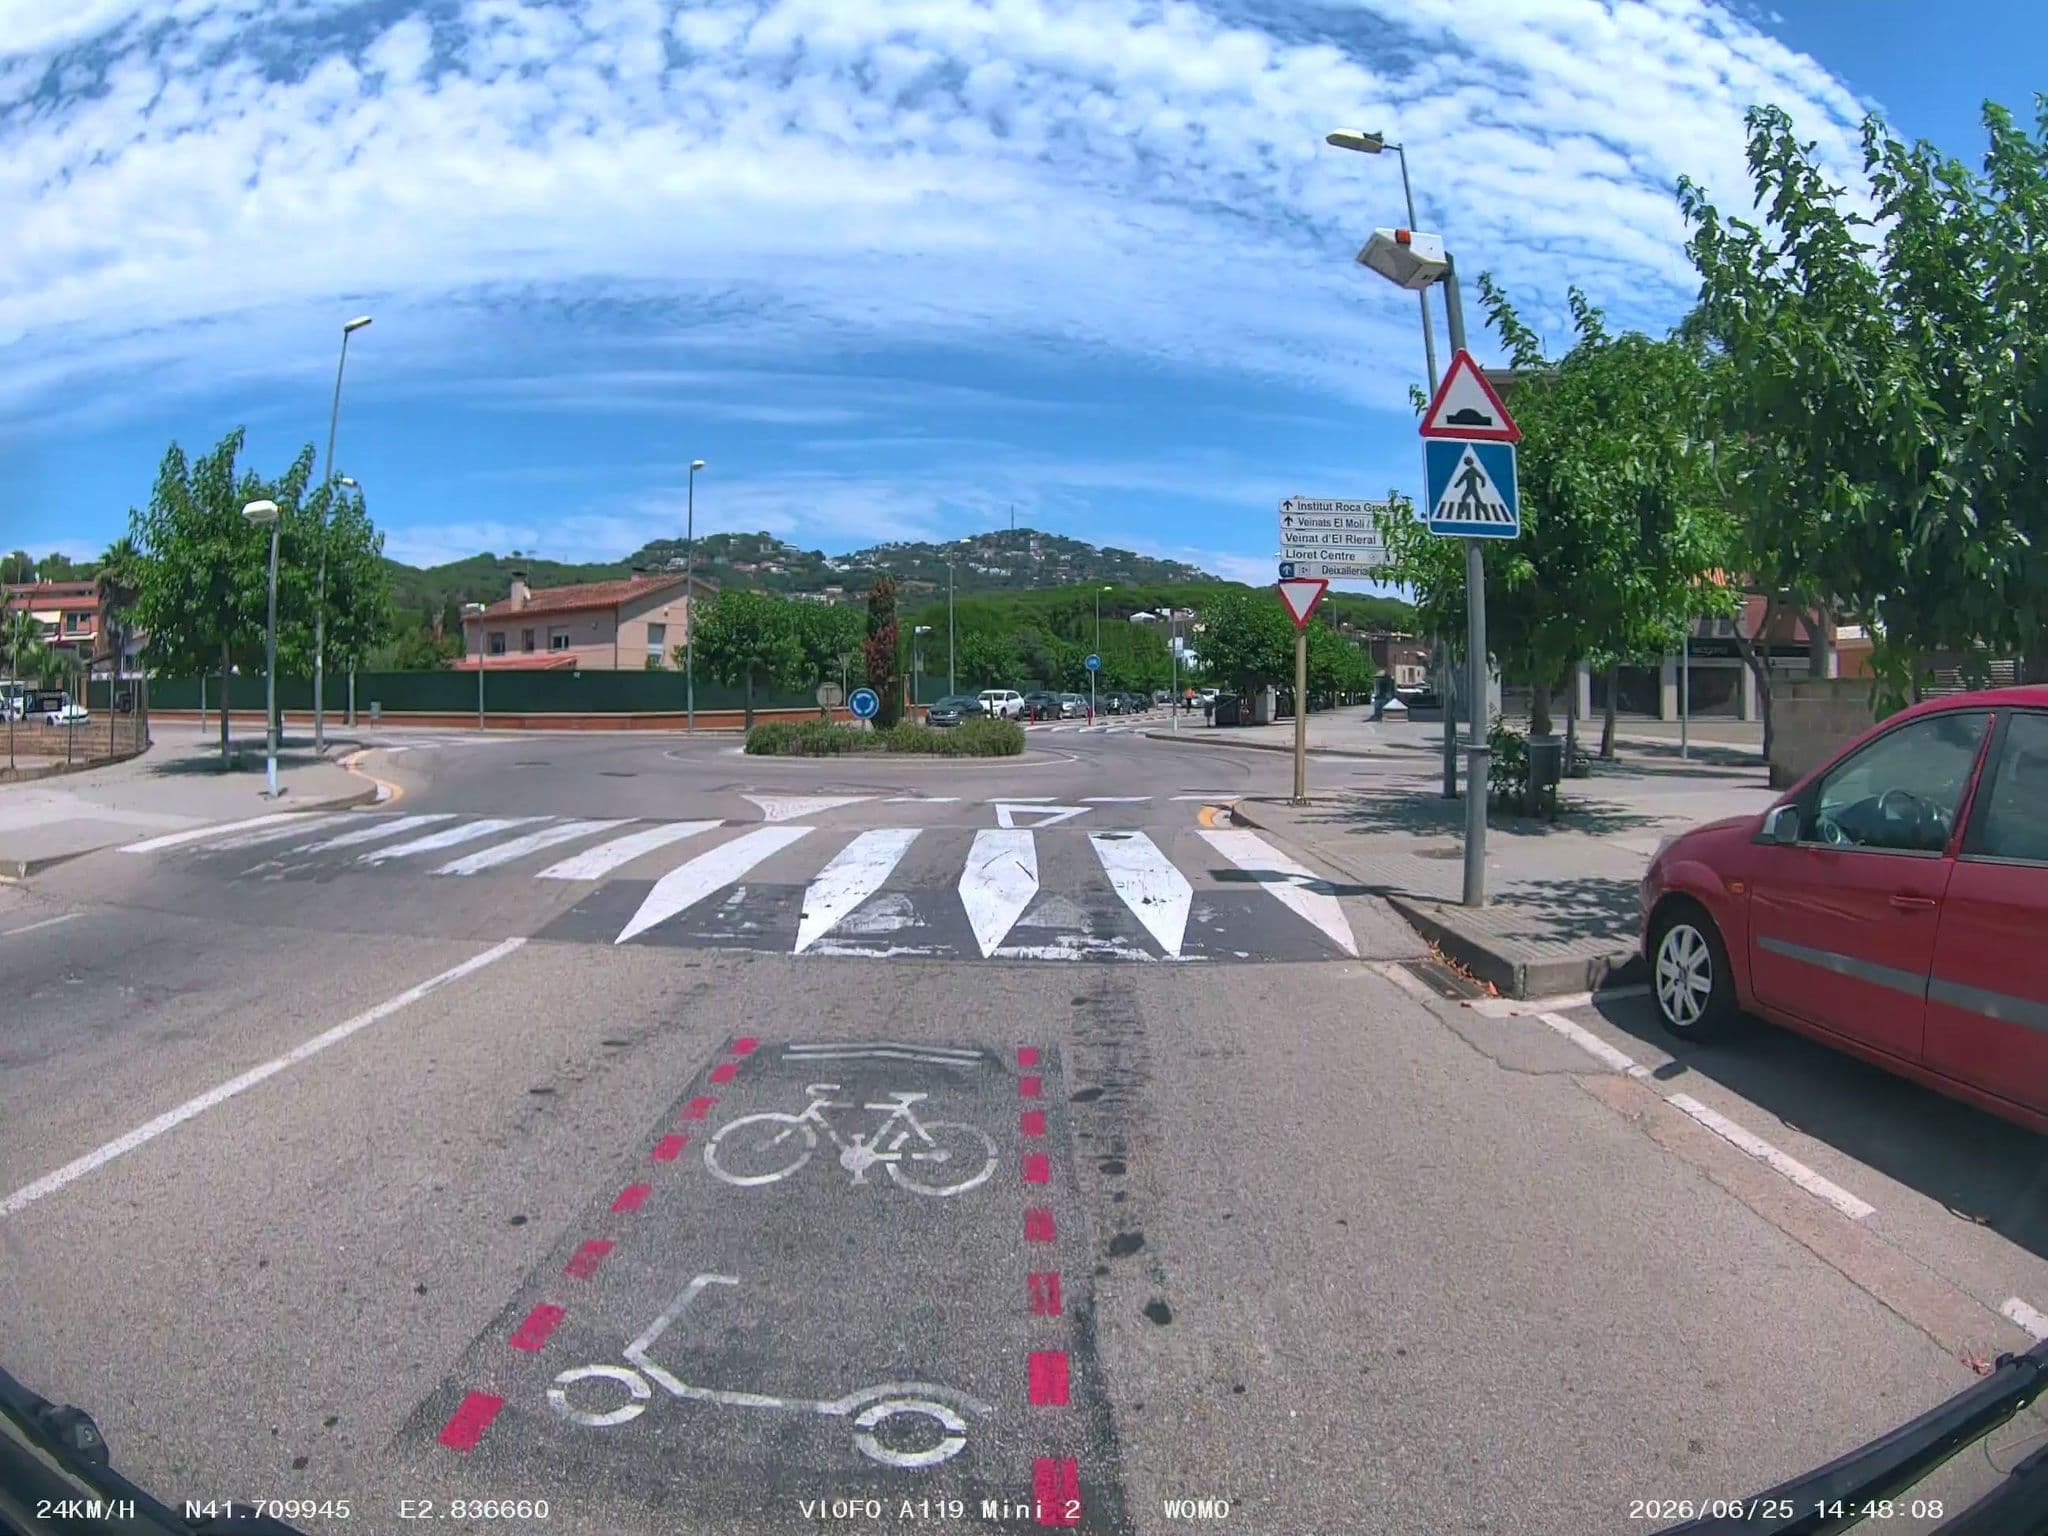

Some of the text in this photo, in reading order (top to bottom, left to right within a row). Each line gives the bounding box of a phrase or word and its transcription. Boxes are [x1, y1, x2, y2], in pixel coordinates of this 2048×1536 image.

[1297, 501, 1397, 512] Institut Roca Gross
[1334, 518, 1344, 528] El
[1322, 534, 1343, 544] d'El
[1345, 534, 1376, 545] Rieral
[1285, 549, 1356, 561] Lloret Centre
